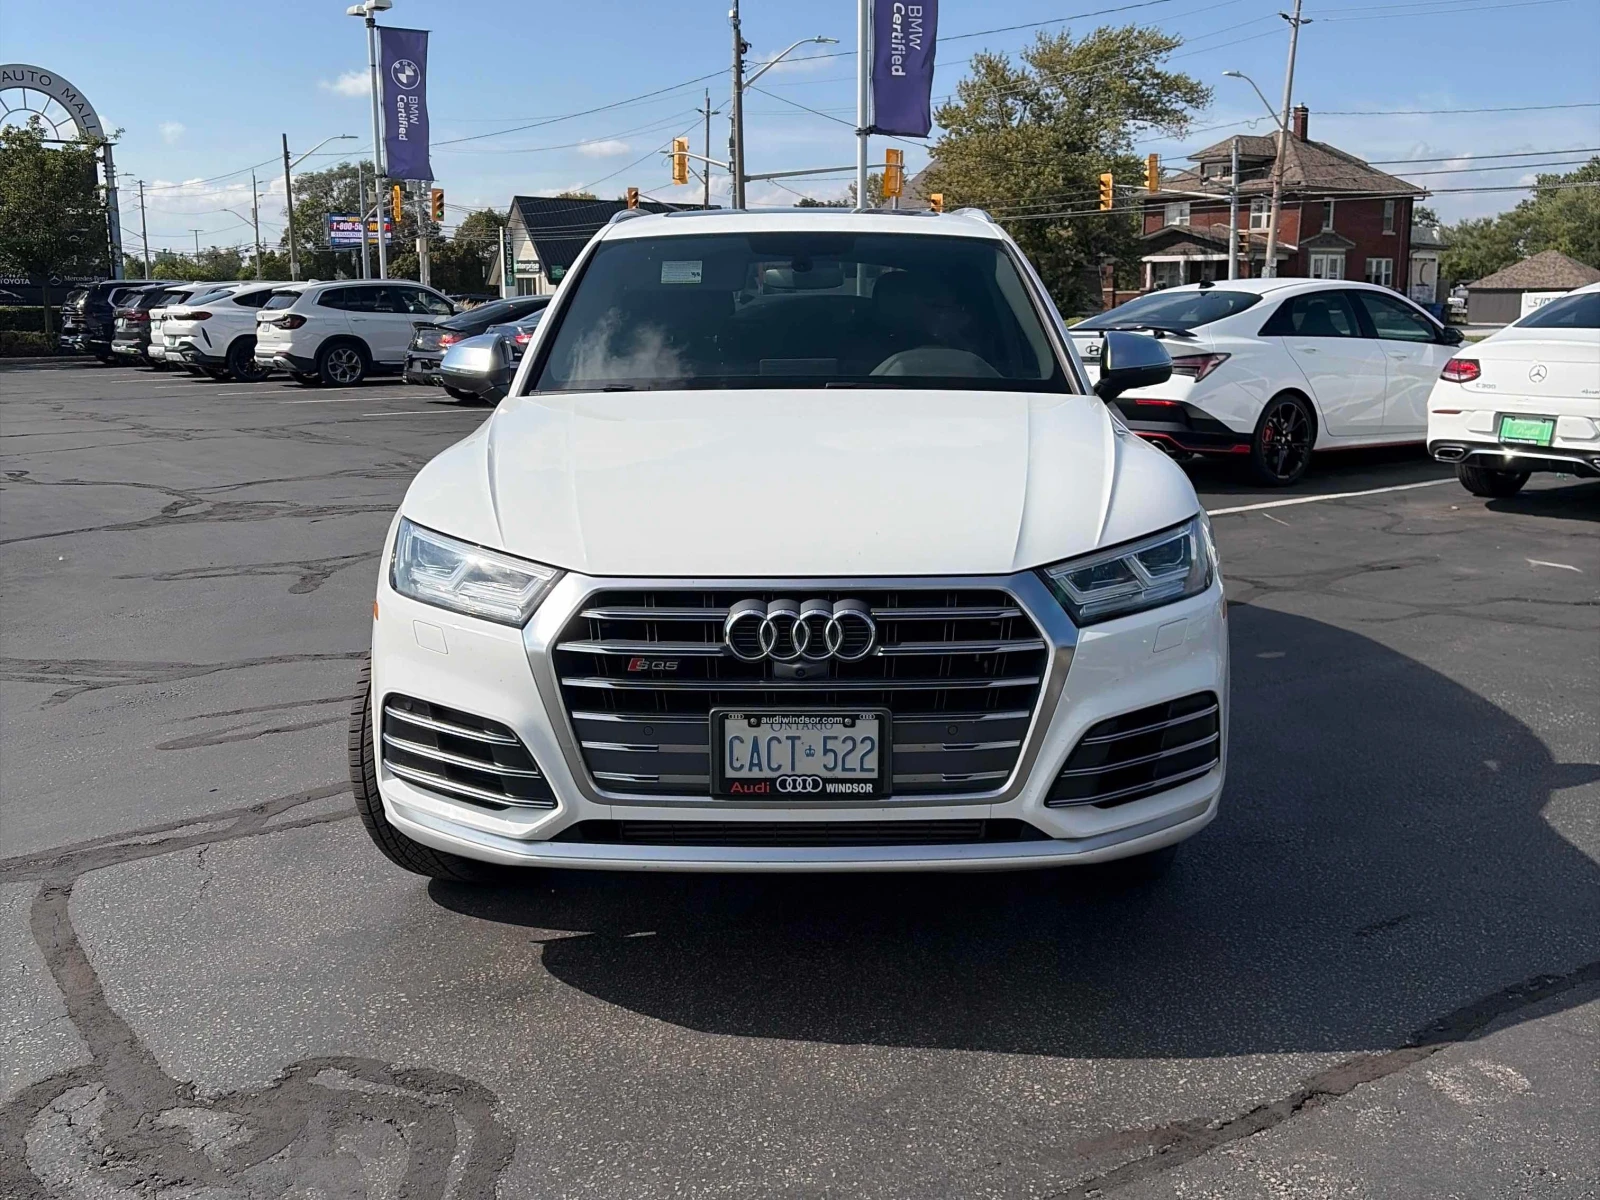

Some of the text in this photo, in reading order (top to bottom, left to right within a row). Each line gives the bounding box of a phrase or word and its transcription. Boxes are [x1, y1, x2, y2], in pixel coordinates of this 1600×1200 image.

[891, 2, 906, 77] Certified
[908, 5, 923, 51] BMW
[2, 70, 96, 135] AUTO MALL
[397, 94, 409, 141] Certified
[409, 96, 419, 125] BMW
[761, 715, 843, 724] audiwindsor.com
[770, 723, 834, 732] ONTARIO
[728, 735, 876, 772] CACT 522
[730, 781, 873, 793] Audi WINDSOR
